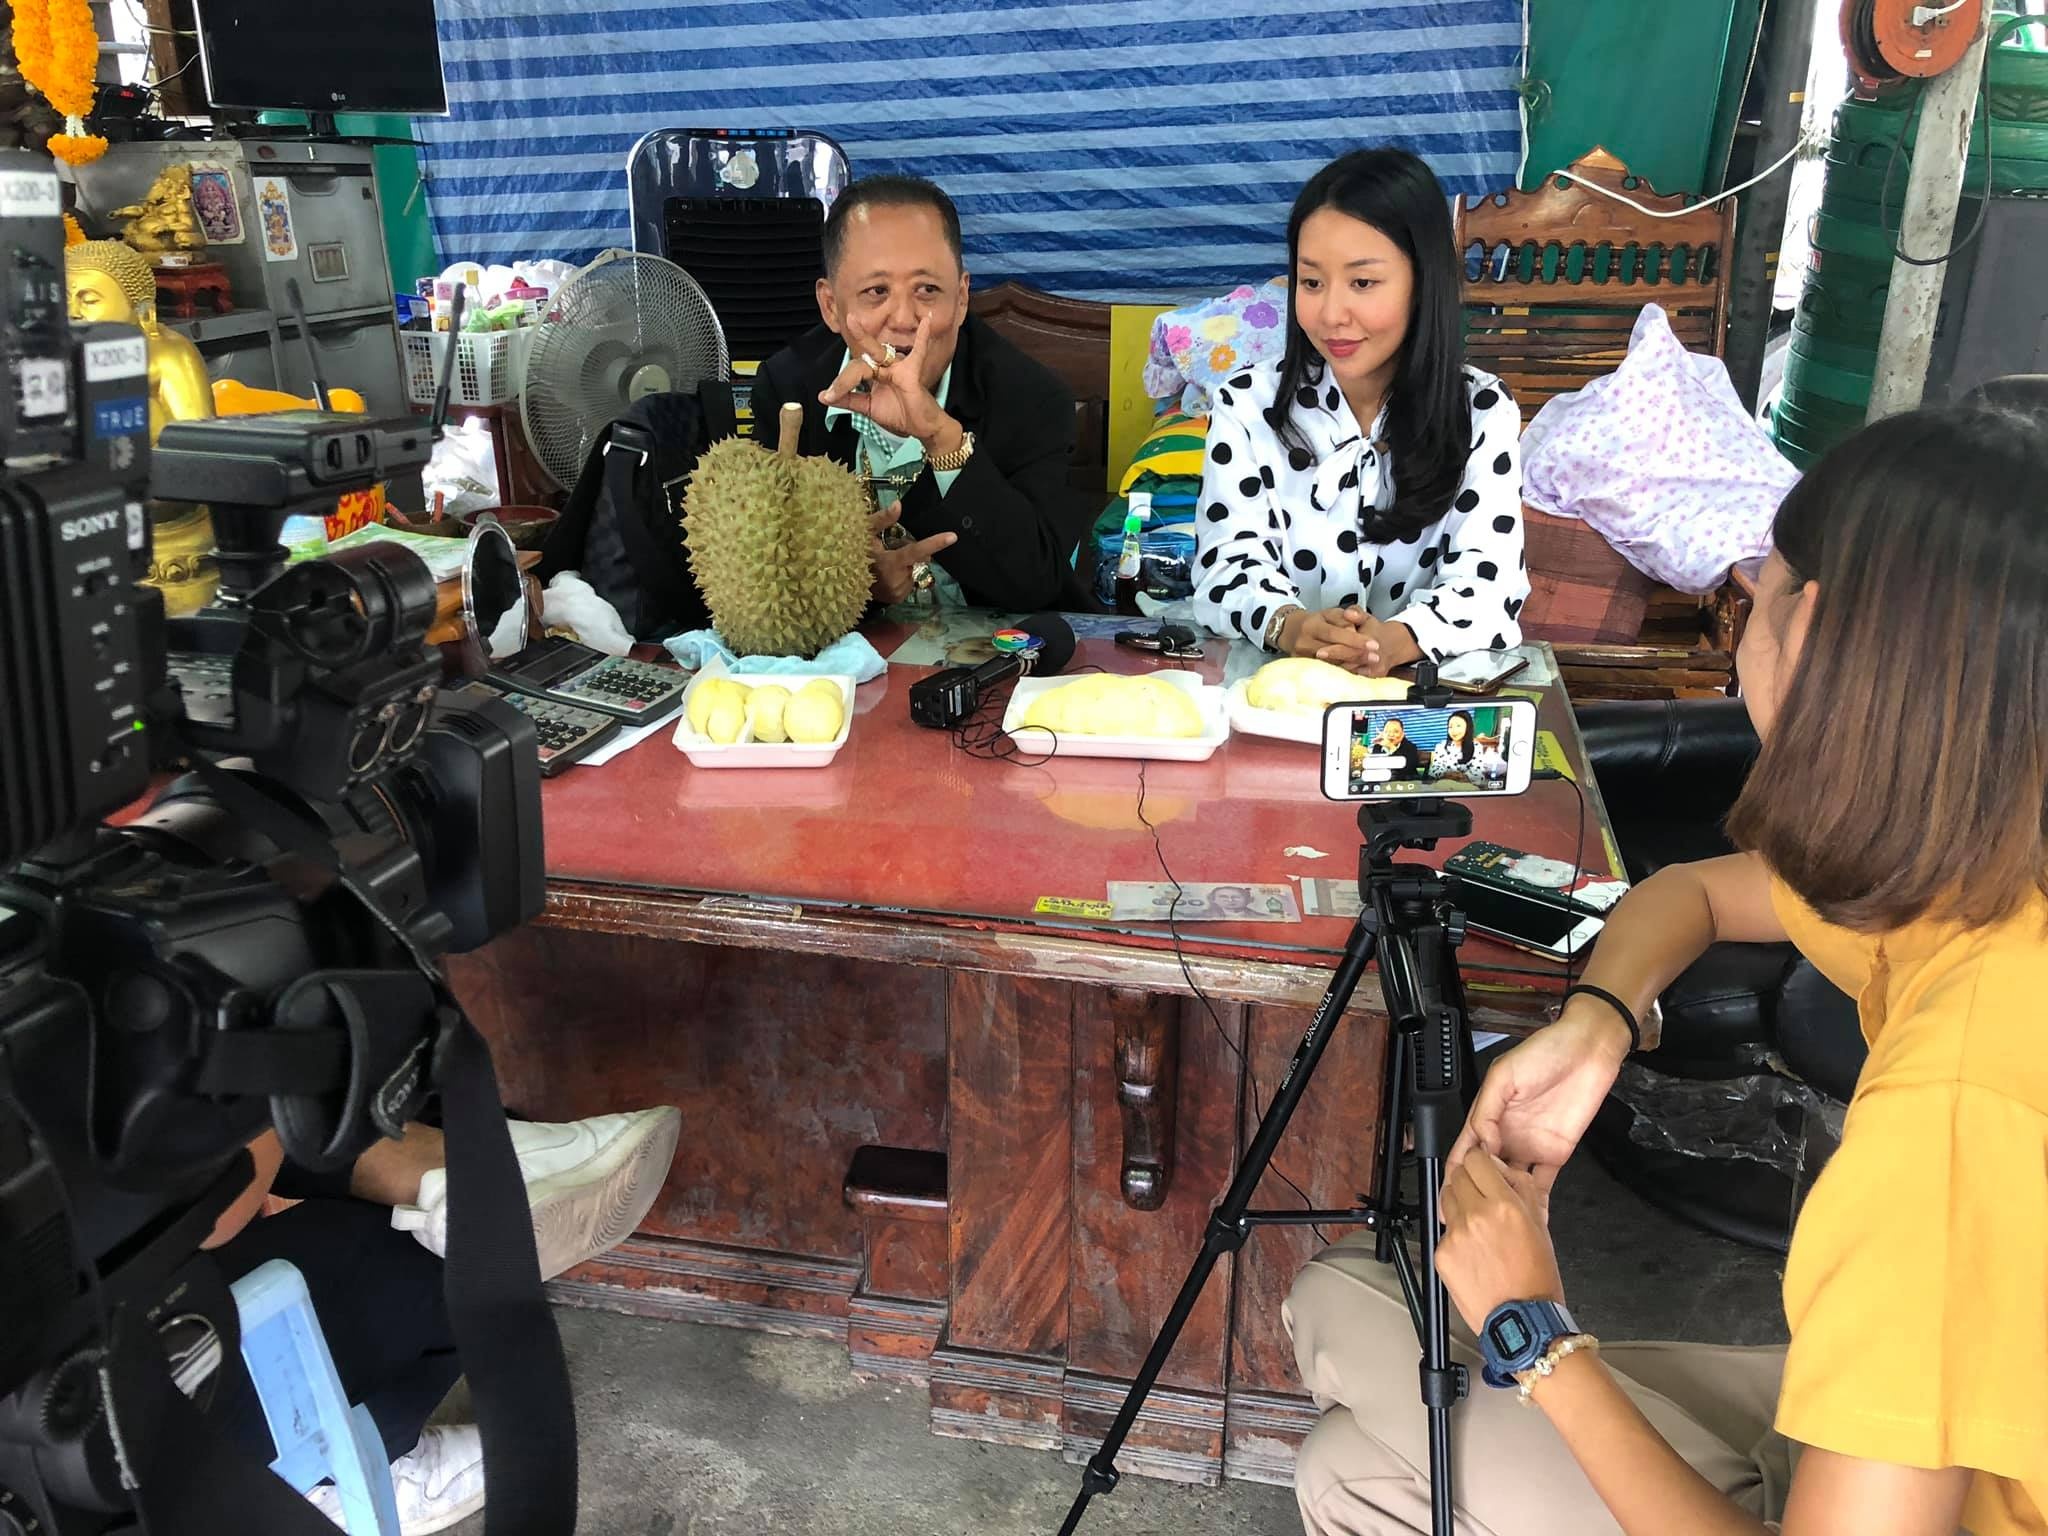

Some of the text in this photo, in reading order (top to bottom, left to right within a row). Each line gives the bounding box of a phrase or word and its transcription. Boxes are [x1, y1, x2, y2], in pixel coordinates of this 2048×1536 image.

[97, 405, 145, 429] TRUE
[60, 510, 119, 541] SONY
[1305, 991, 1334, 1042] YUNTENG
